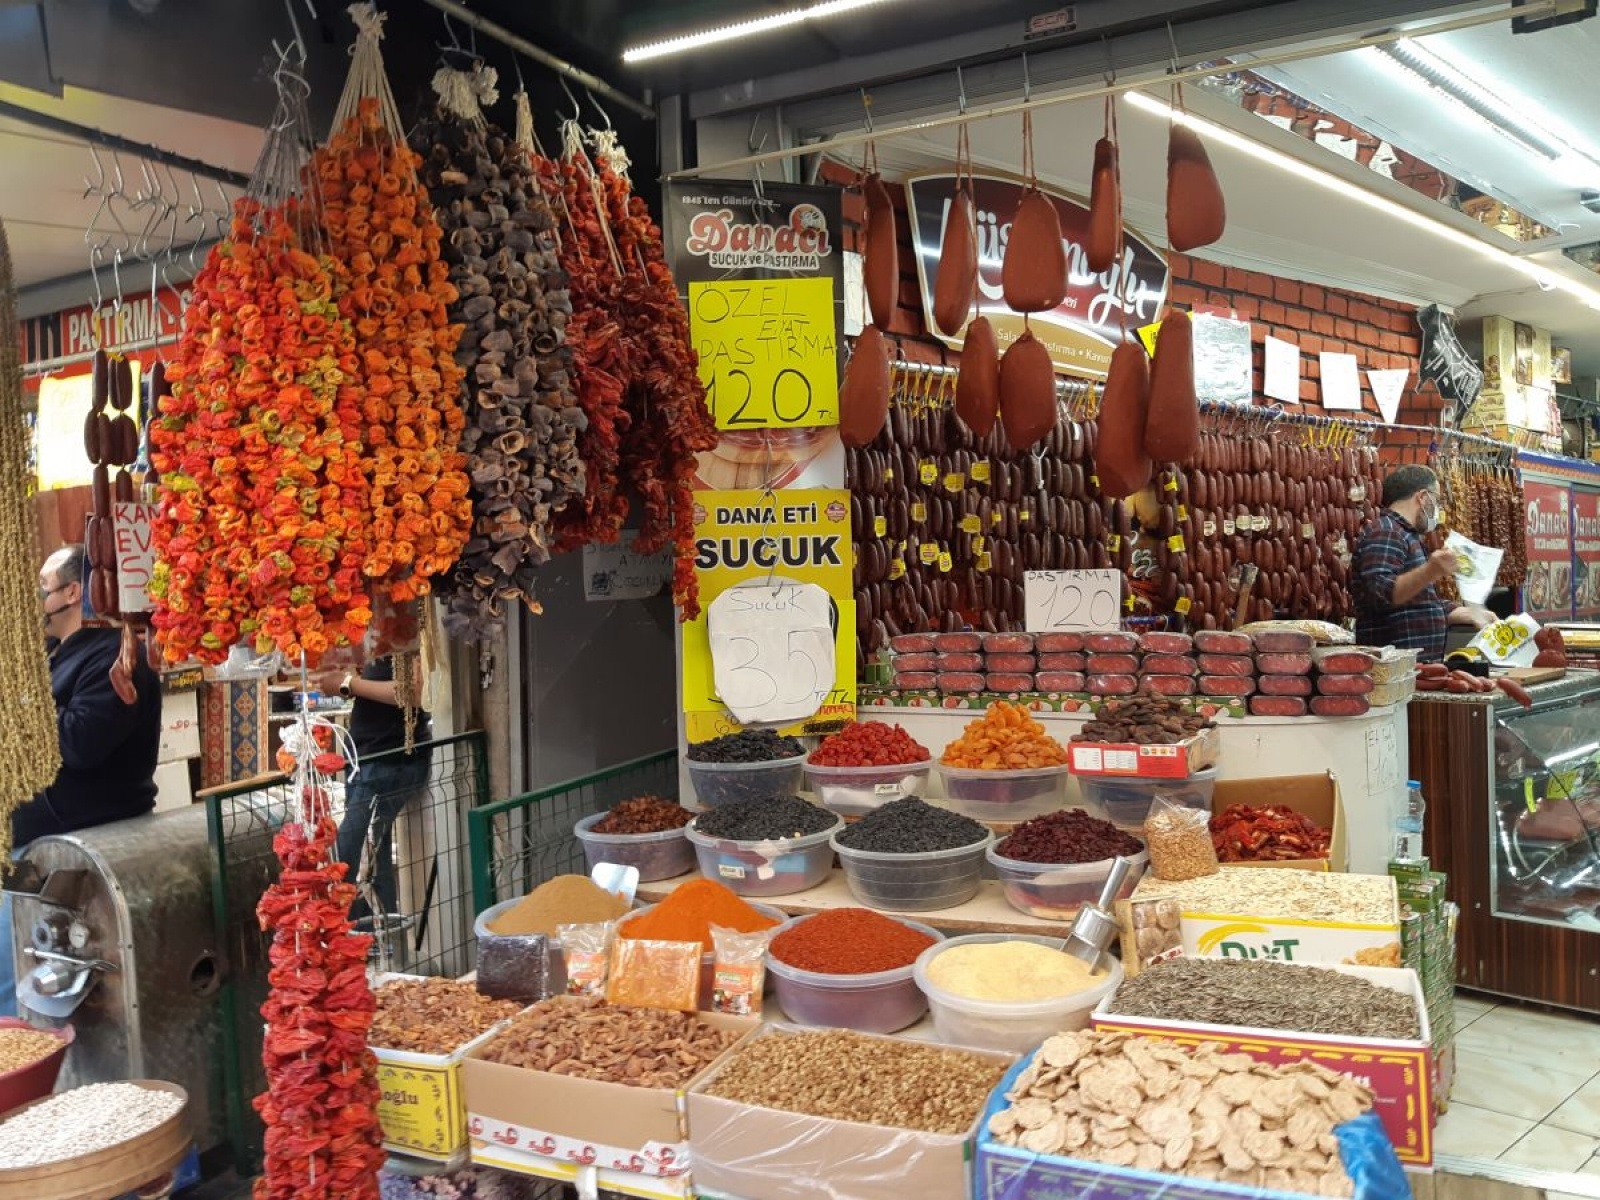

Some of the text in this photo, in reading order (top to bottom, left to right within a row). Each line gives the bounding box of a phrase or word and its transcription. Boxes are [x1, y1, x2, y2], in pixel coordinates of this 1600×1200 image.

[711, 254, 746, 266] SUCUK
[696, 283, 806, 323] ÖZEL
[705, 368, 812, 424] 120
[716, 502, 818, 525] DANA ETİ
[695, 535, 842, 569] SUCUK
[1040, 584, 1115, 628] 120
[723, 630, 818, 708] 35
